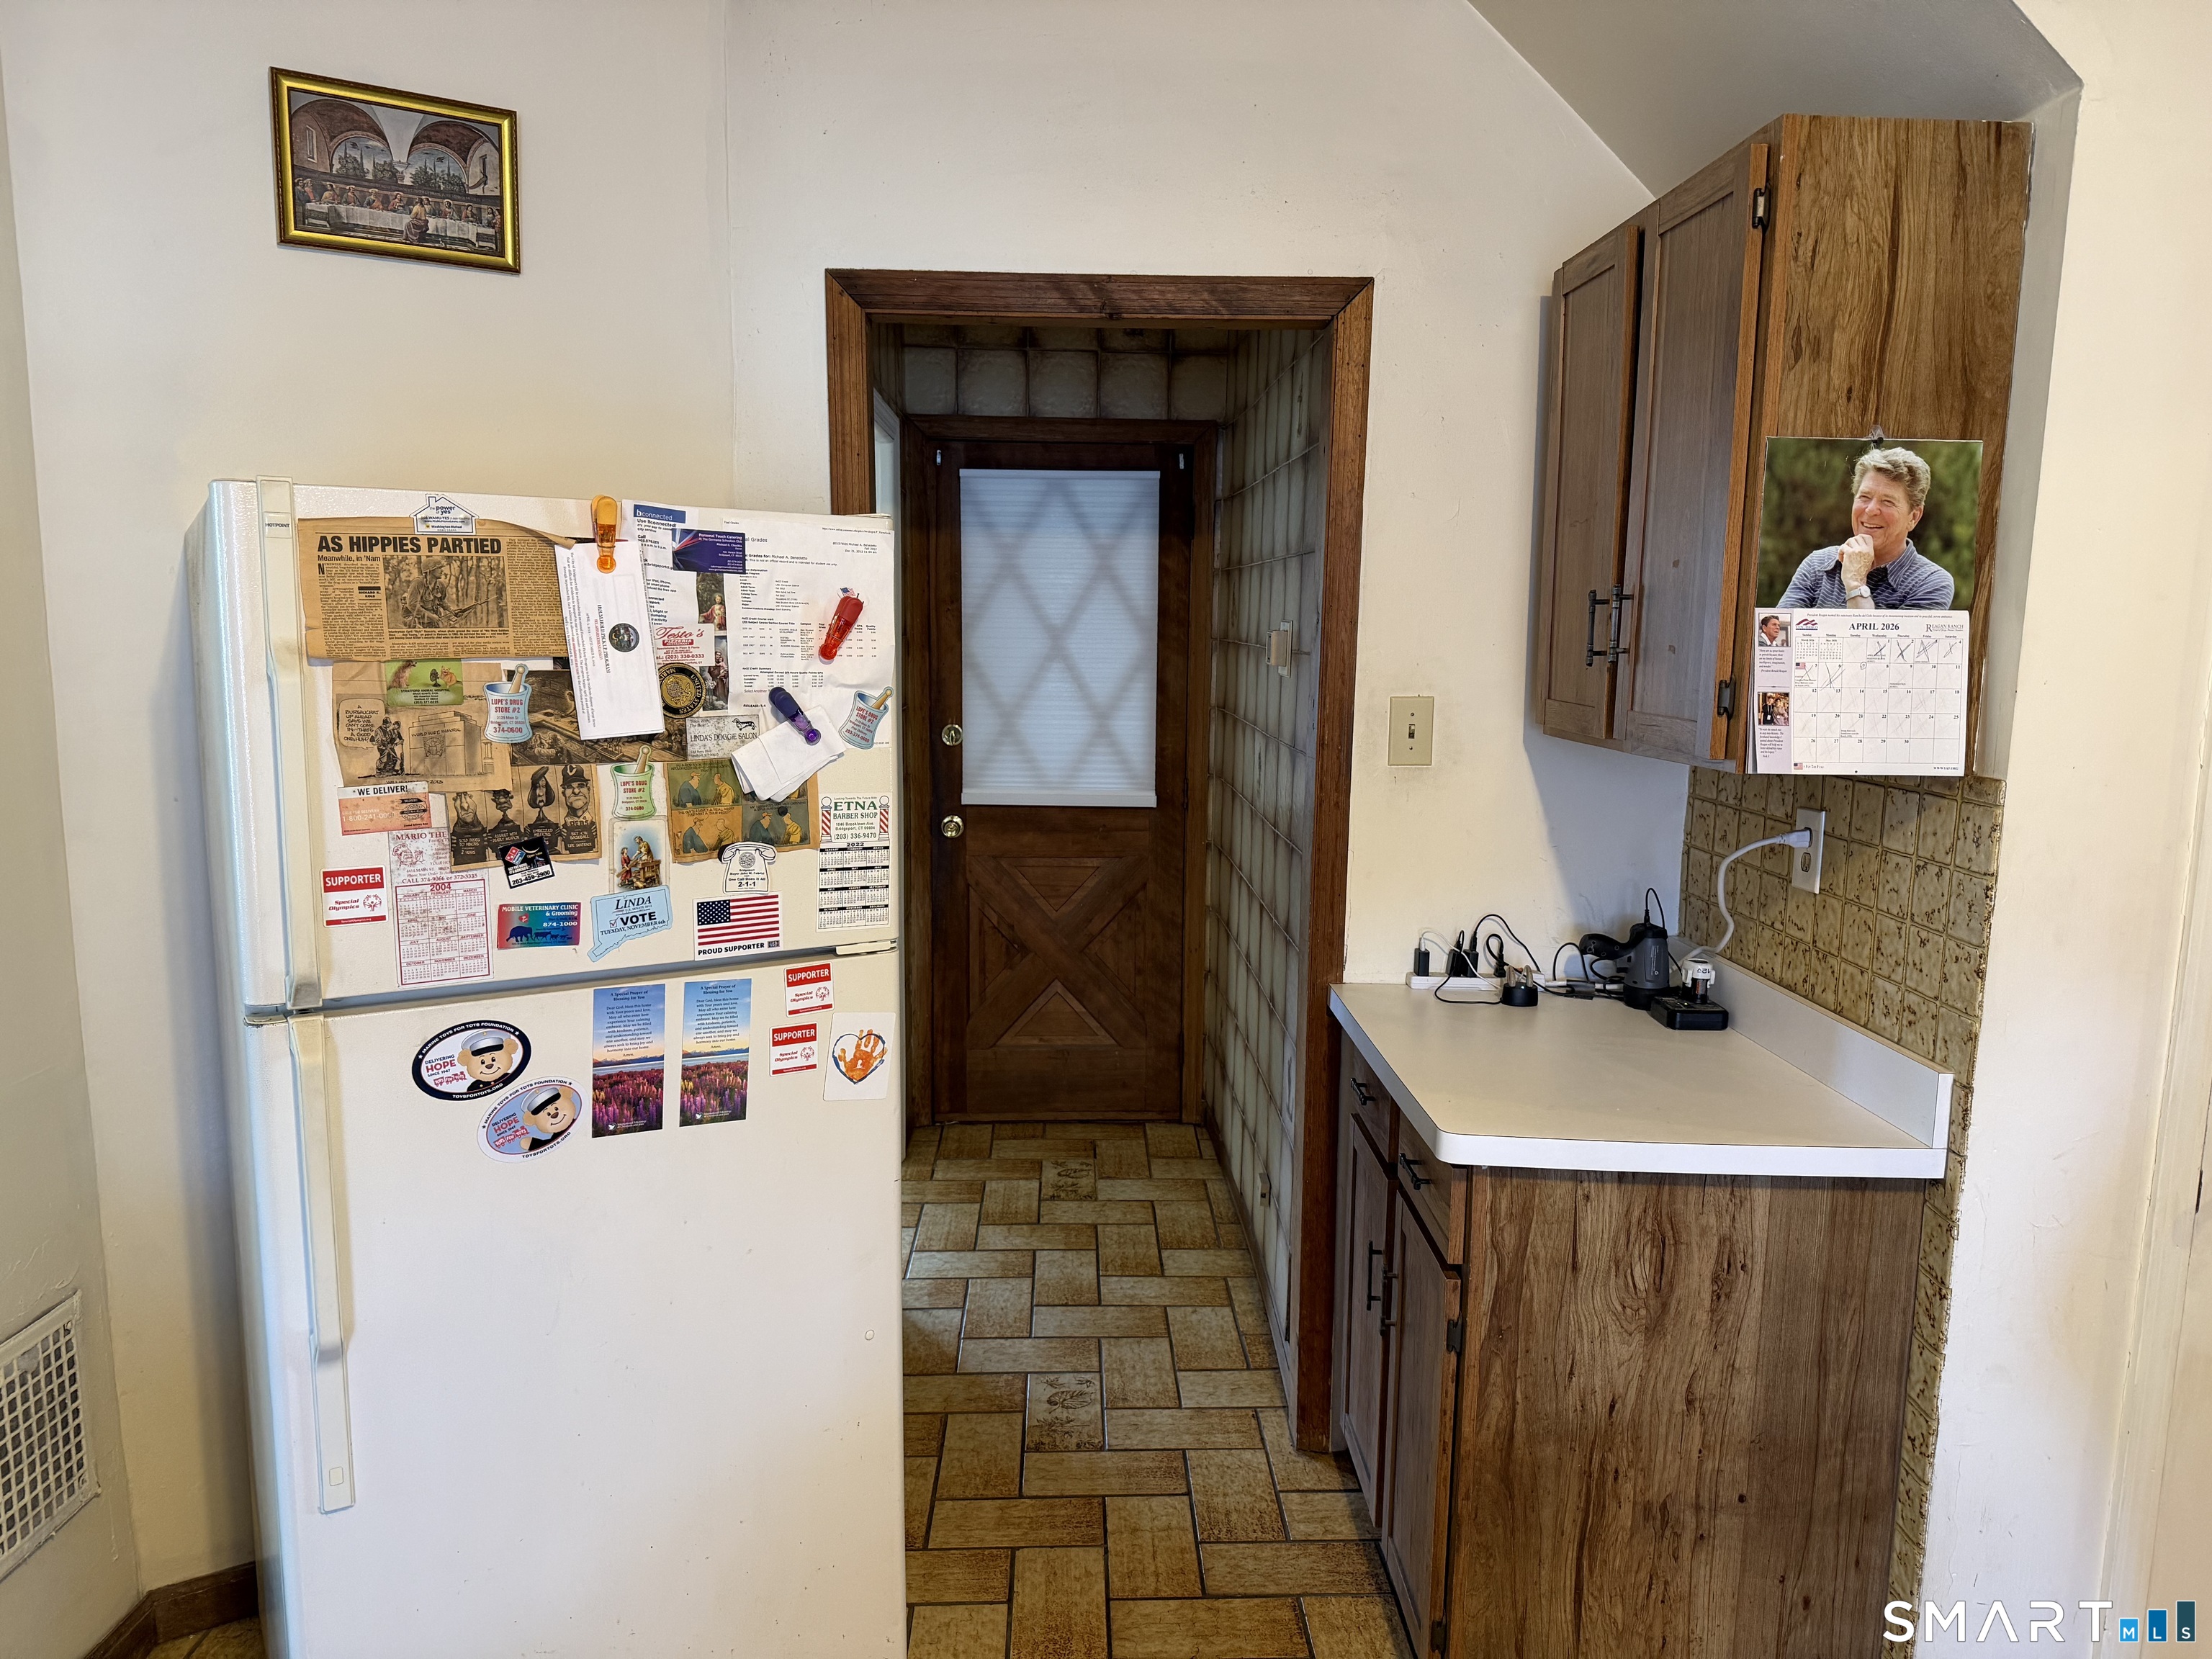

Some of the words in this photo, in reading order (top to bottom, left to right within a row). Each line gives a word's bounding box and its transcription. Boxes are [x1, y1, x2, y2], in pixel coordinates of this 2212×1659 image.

[637, 509, 673, 521] bconnected
[318, 536, 343, 552] AS
[349, 536, 421, 553] HIPPIES
[427, 537, 502, 554] PARTIED
[654, 626, 705, 640] Testo's
[1849, 622, 1879, 631] APRIL
[1881, 622, 1900, 631] 2026
[691, 674, 702, 698] UNITED
[679, 698, 700, 714] STATES
[855, 706, 868, 715] LUPE'S
[868, 711, 878, 720] DRUG
[855, 712, 868, 721] STORE
[845, 729, 870, 743] 203-374-0600
[373, 785, 408, 795] DELIVER!
[834, 801, 878, 811] ETNA
[396, 832, 427, 841] MARIO
[325, 873, 382, 886] SUPPORTER
[511, 870, 551, 885] 203-459-2900
[430, 883, 451, 892] 2004
[614, 896, 652, 910] LINDA
[620, 912, 657, 926] VOTE
[600, 926, 626, 935] TUESDAY,
[626, 921, 658, 931] NOVEMBER
[724, 943, 765, 953] SUPPORTER
[788, 968, 830, 982] SUPPORTER
[421, 1038, 440, 1053] MARINE
[440, 1029, 454, 1039] TOYS
[481, 1022, 515, 1033] FOUNDATION
[773, 1028, 815, 1042] SUPPORTER
[425, 1054, 455, 1065] DELIVERING
[426, 1059, 457, 1074] HOPE
[452, 1083, 504, 1099] TOYSFORTOTS.ORG
[484, 1107, 498, 1124] MARINE
[497, 1096, 510, 1107] TOYS
[508, 1088, 520, 1097] FOR
[519, 1082, 534, 1091] TOTS
[491, 1112, 517, 1128] DELIVERING
[493, 1116, 520, 1134] HOPE
[521, 1131, 571, 1159] TOYSFORTOTS.ORG
